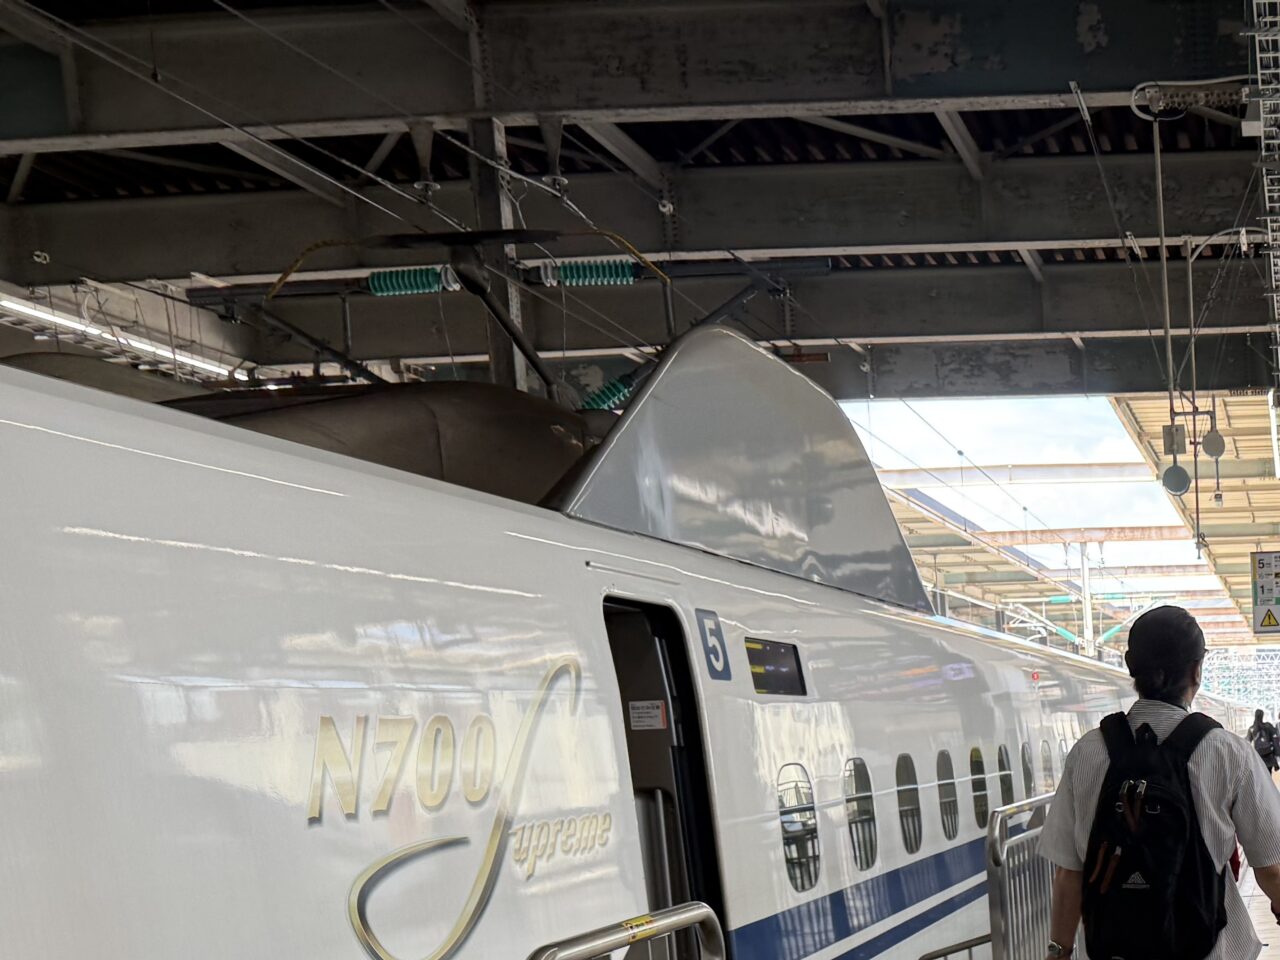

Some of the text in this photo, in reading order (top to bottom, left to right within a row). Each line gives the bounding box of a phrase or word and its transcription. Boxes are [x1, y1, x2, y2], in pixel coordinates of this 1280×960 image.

[1258, 559, 1265, 569] 5
[1259, 585, 1265, 594] 1
[704, 617, 725, 672] 5
[306, 712, 497, 822] N700
